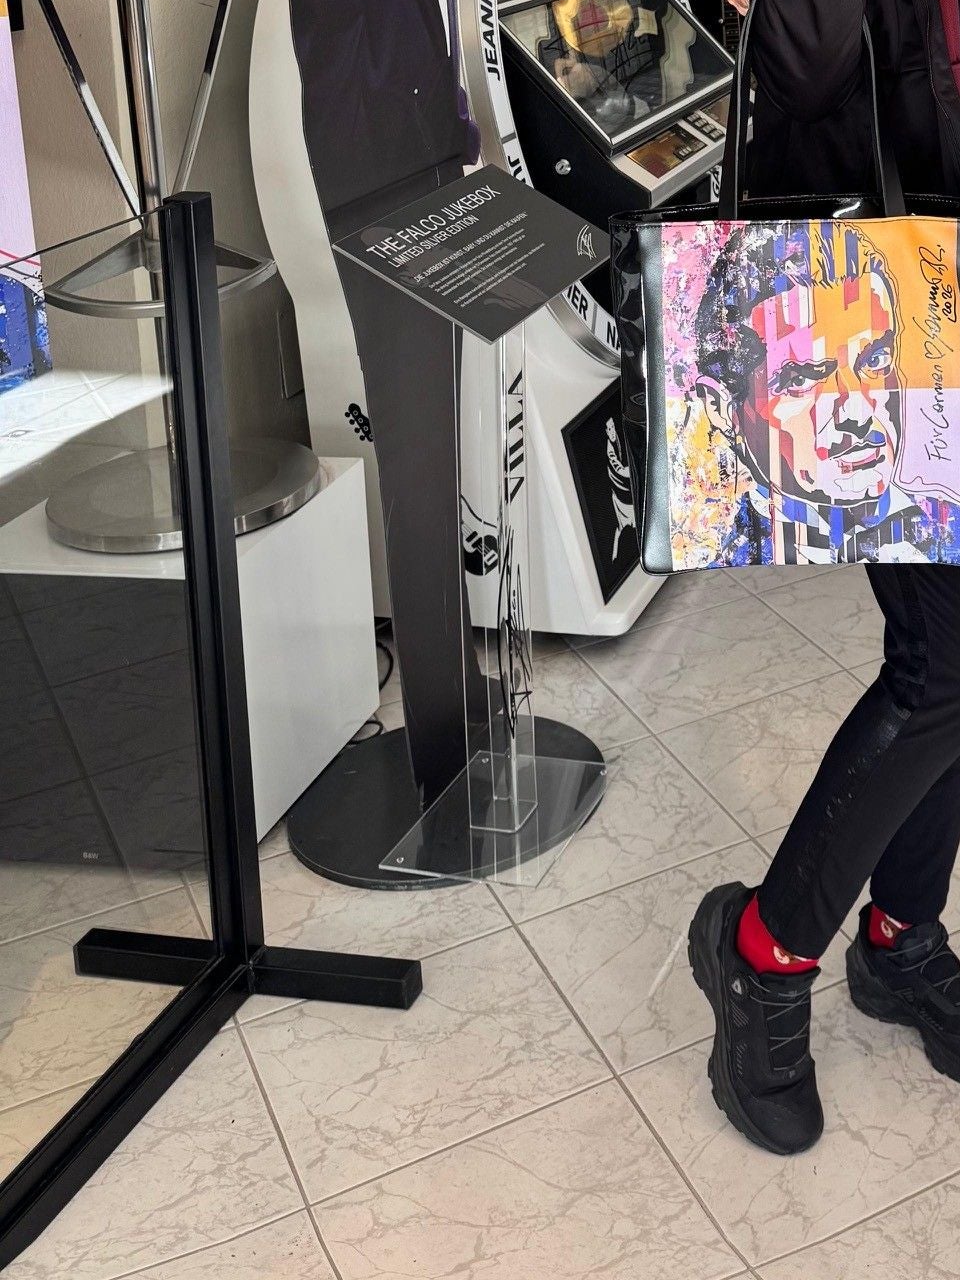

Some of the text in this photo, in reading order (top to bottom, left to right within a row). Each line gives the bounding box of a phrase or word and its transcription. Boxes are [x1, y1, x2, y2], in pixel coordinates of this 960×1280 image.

[365, 232, 406, 259] THE
[396, 214, 447, 245] FALCO
[440, 184, 501, 221] JUKEBOX
[387, 214, 480, 269] LIMITED SILVER EDITION
[941, 283, 954, 318] 2026
[920, 364, 949, 429] Carmen
[924, 429, 951, 462] Für
